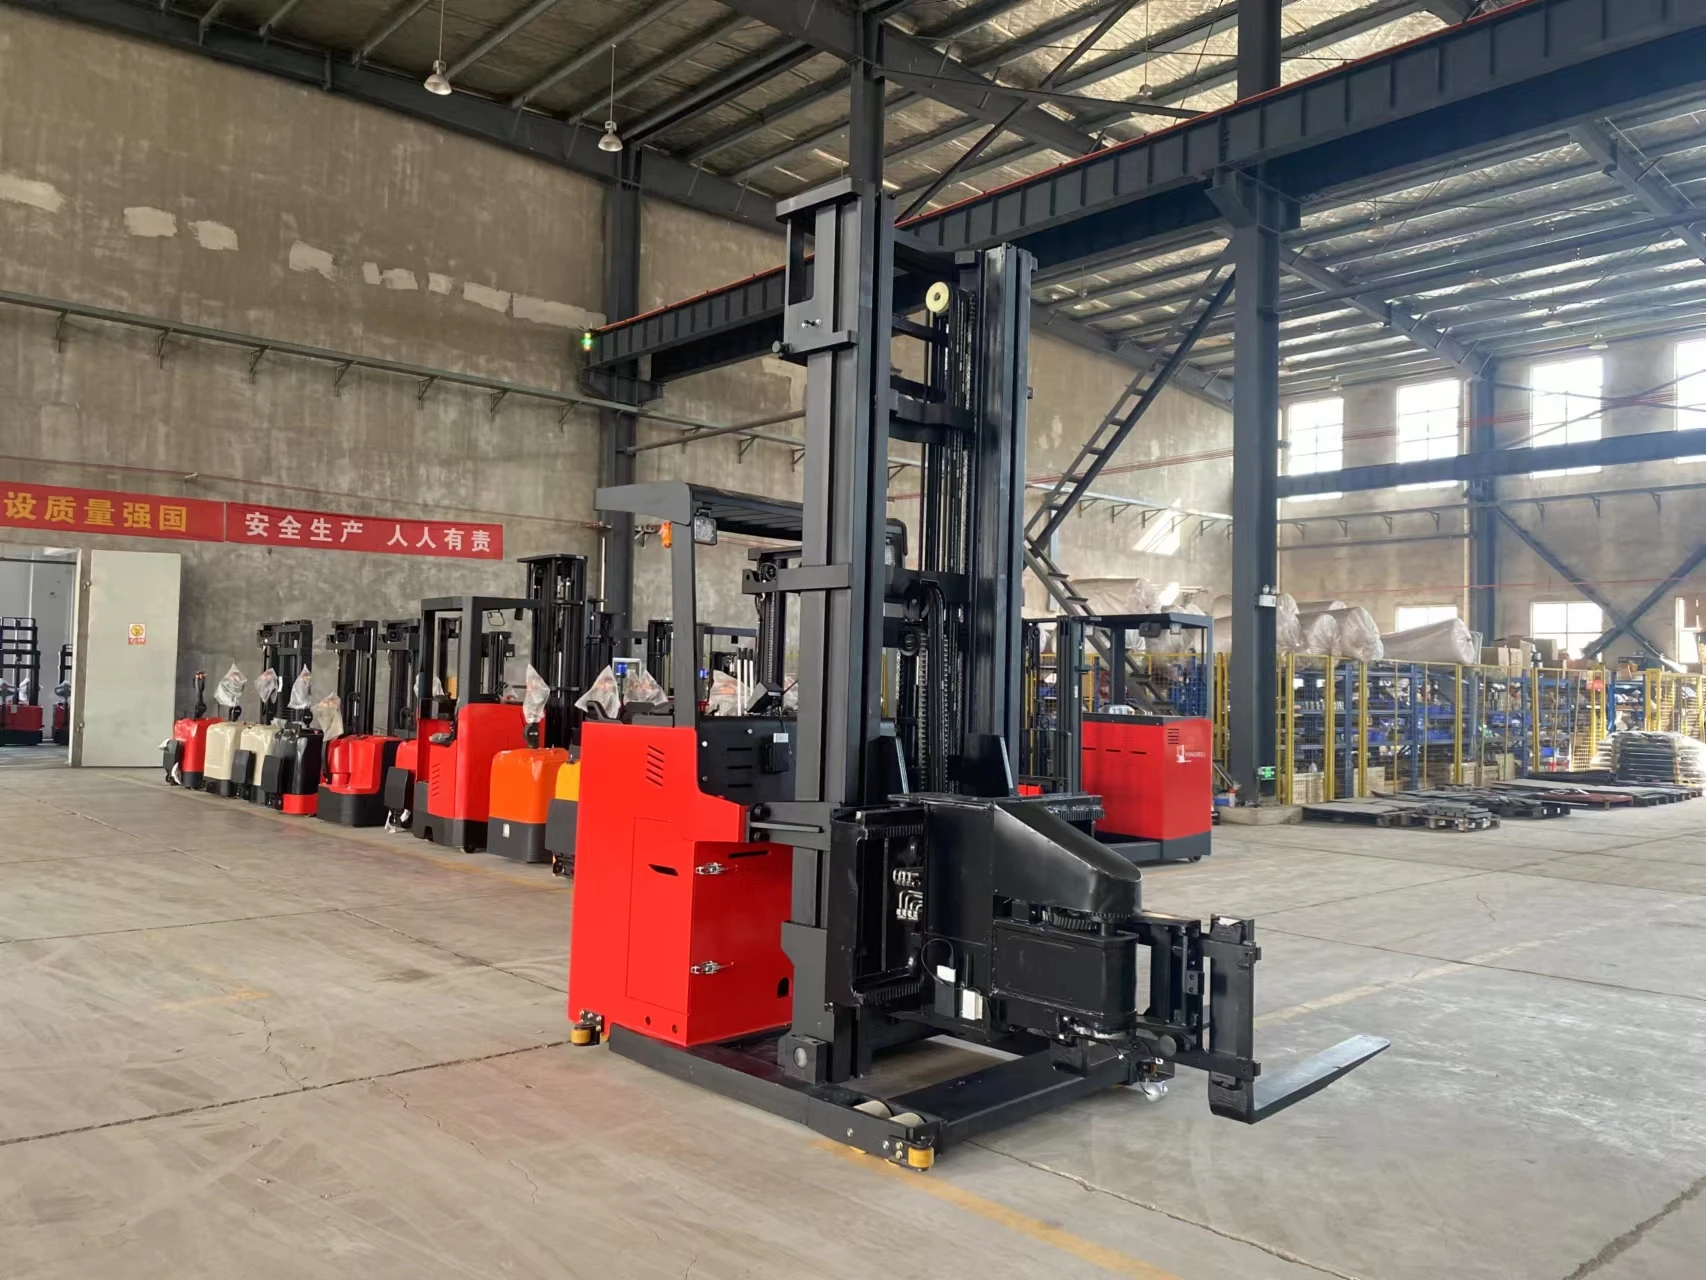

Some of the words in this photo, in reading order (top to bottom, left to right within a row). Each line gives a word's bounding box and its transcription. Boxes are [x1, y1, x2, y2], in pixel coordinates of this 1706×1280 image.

[4, 491, 187, 532] 设质量强国
[245, 512, 363, 543] 安全生产
[387, 525, 491, 553] 人人有责
